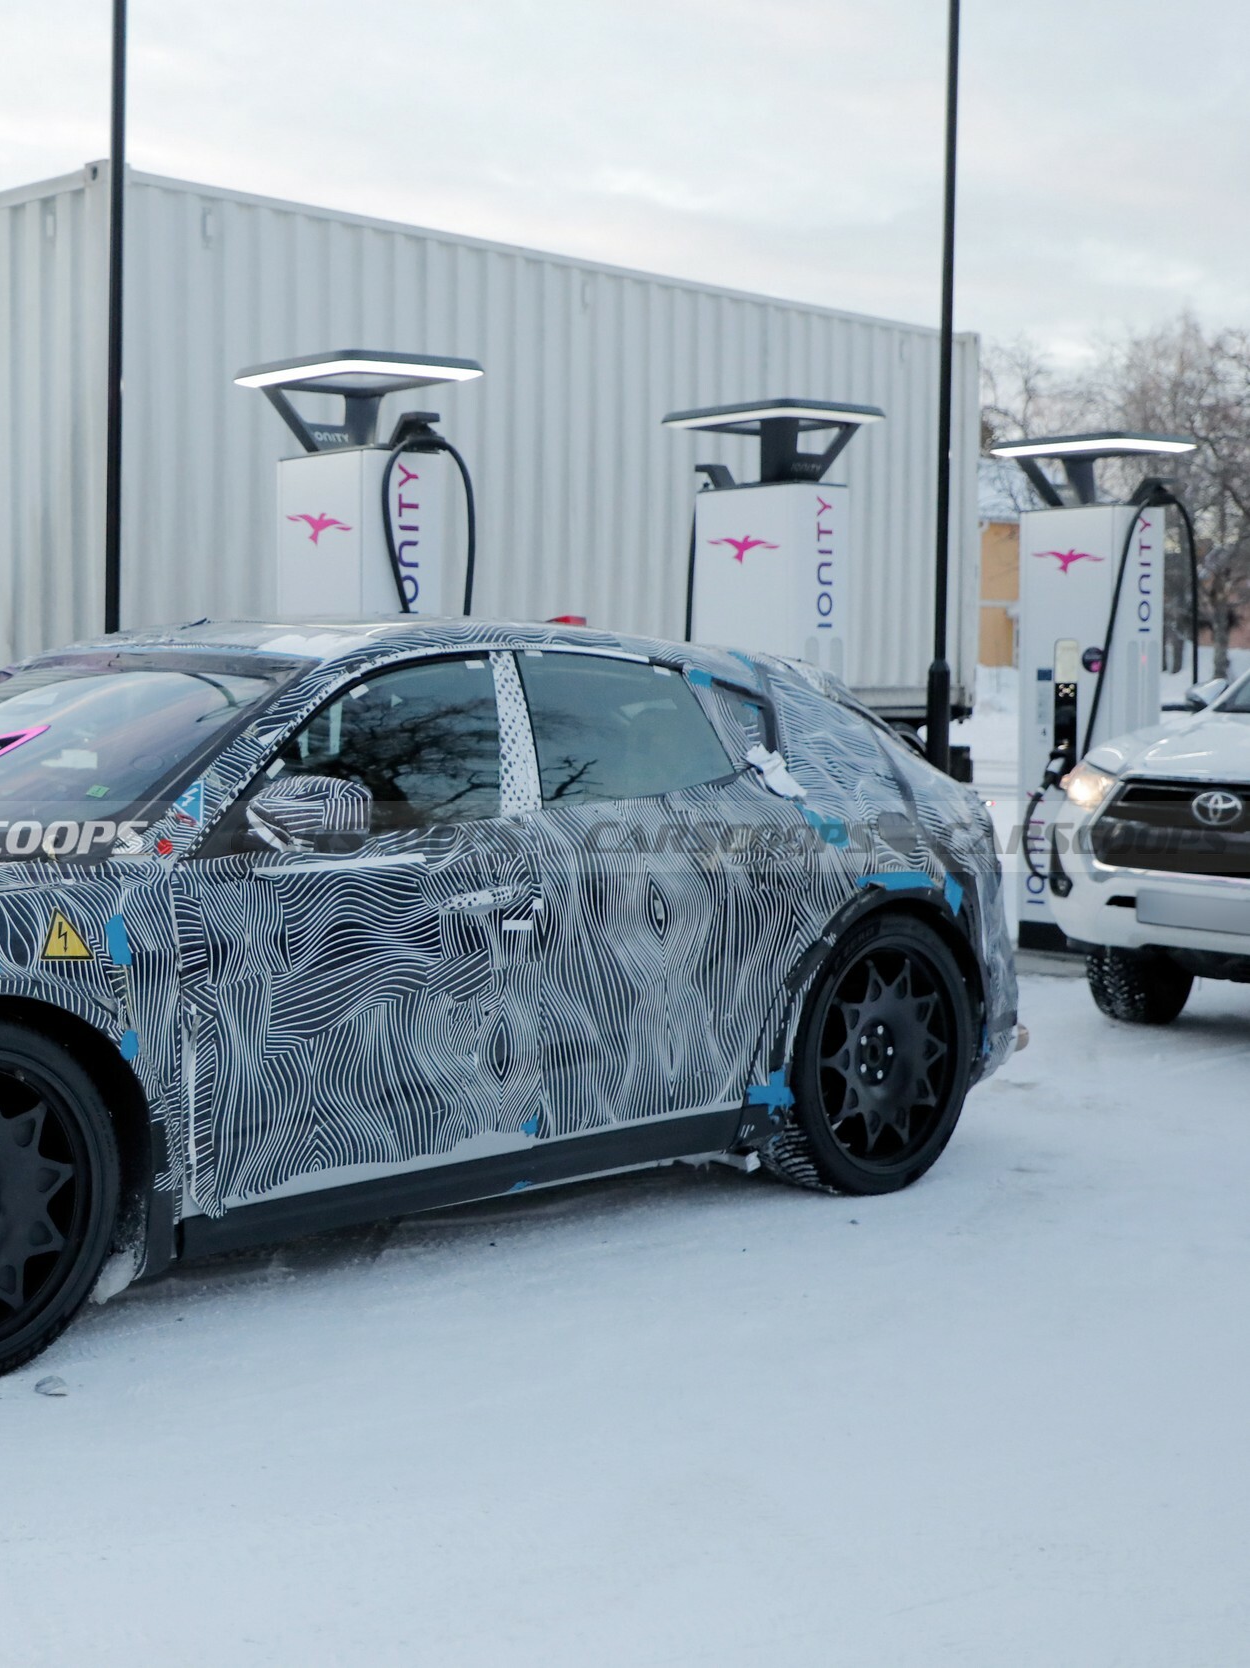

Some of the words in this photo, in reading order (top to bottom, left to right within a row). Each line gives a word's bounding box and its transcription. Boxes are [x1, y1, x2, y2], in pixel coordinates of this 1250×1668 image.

[314, 431, 349, 443] ONITY
[816, 495, 833, 629] IONITY
[1137, 516, 1152, 633] IONITY
